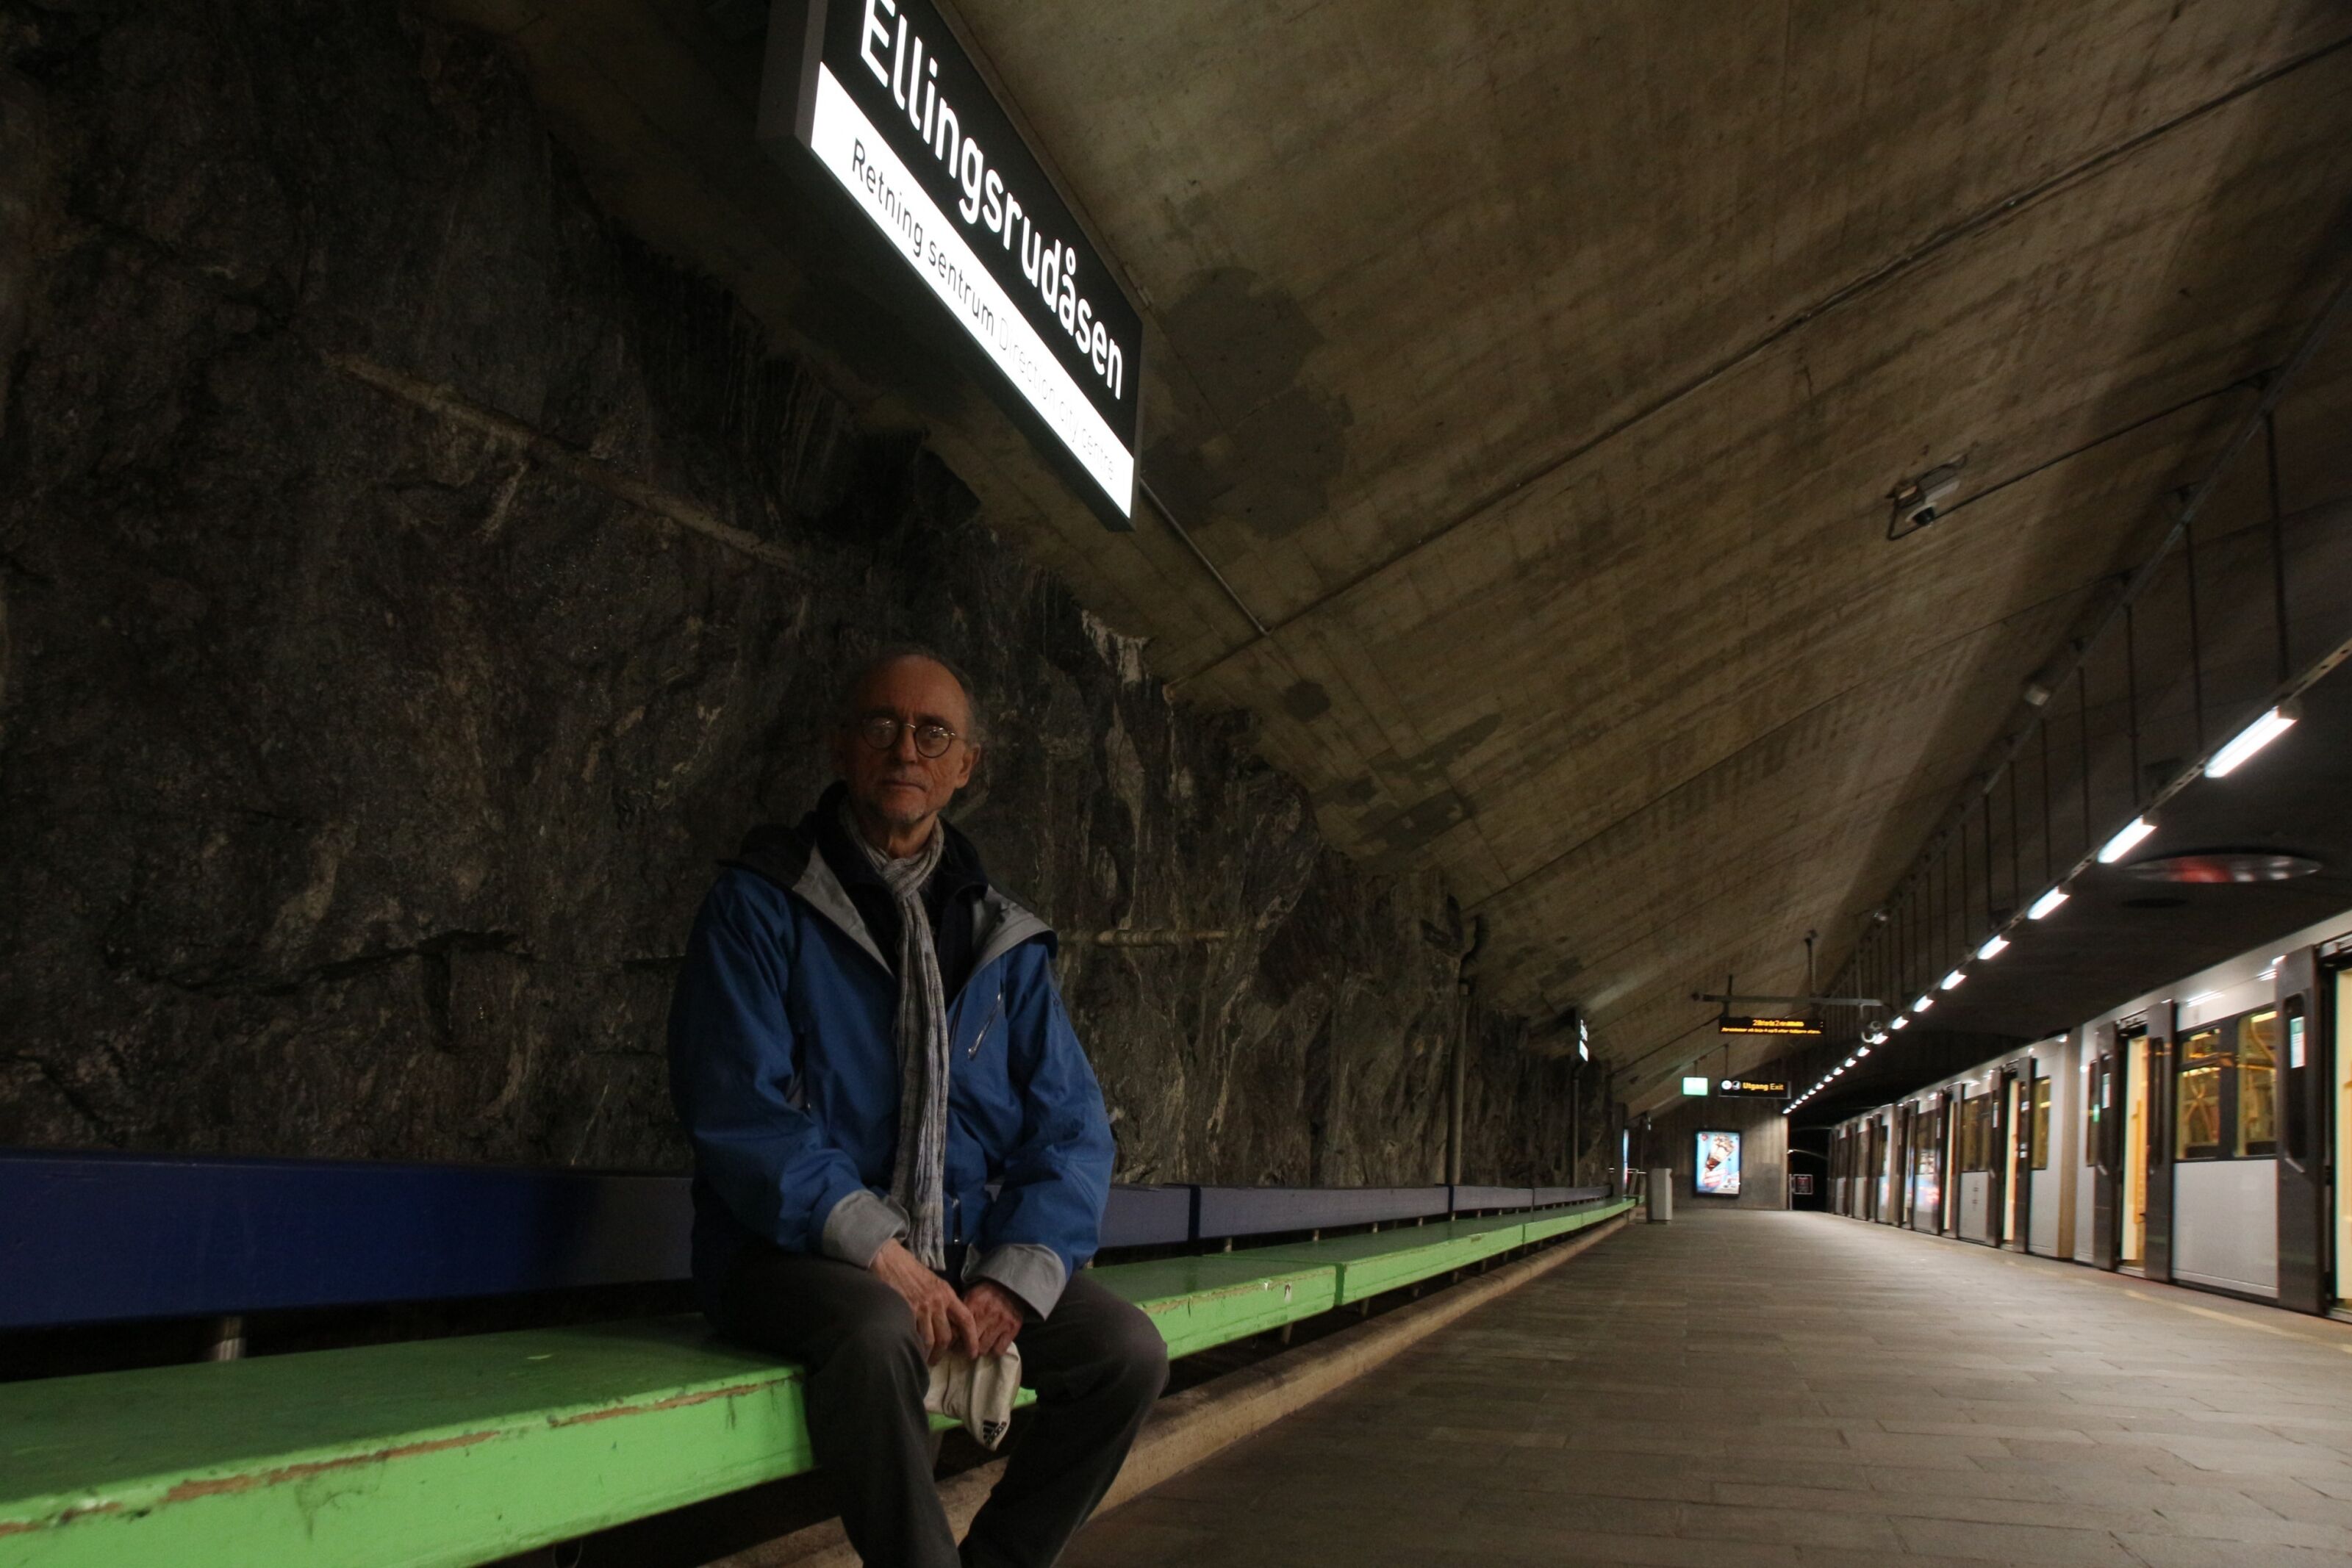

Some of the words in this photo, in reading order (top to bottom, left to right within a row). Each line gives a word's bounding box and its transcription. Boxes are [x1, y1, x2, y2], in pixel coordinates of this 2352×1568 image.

[852, 137, 923, 258] Retning
[928, 240, 994, 337] sentrum
[861, 0, 1122, 400] Ellingsrudåsen
